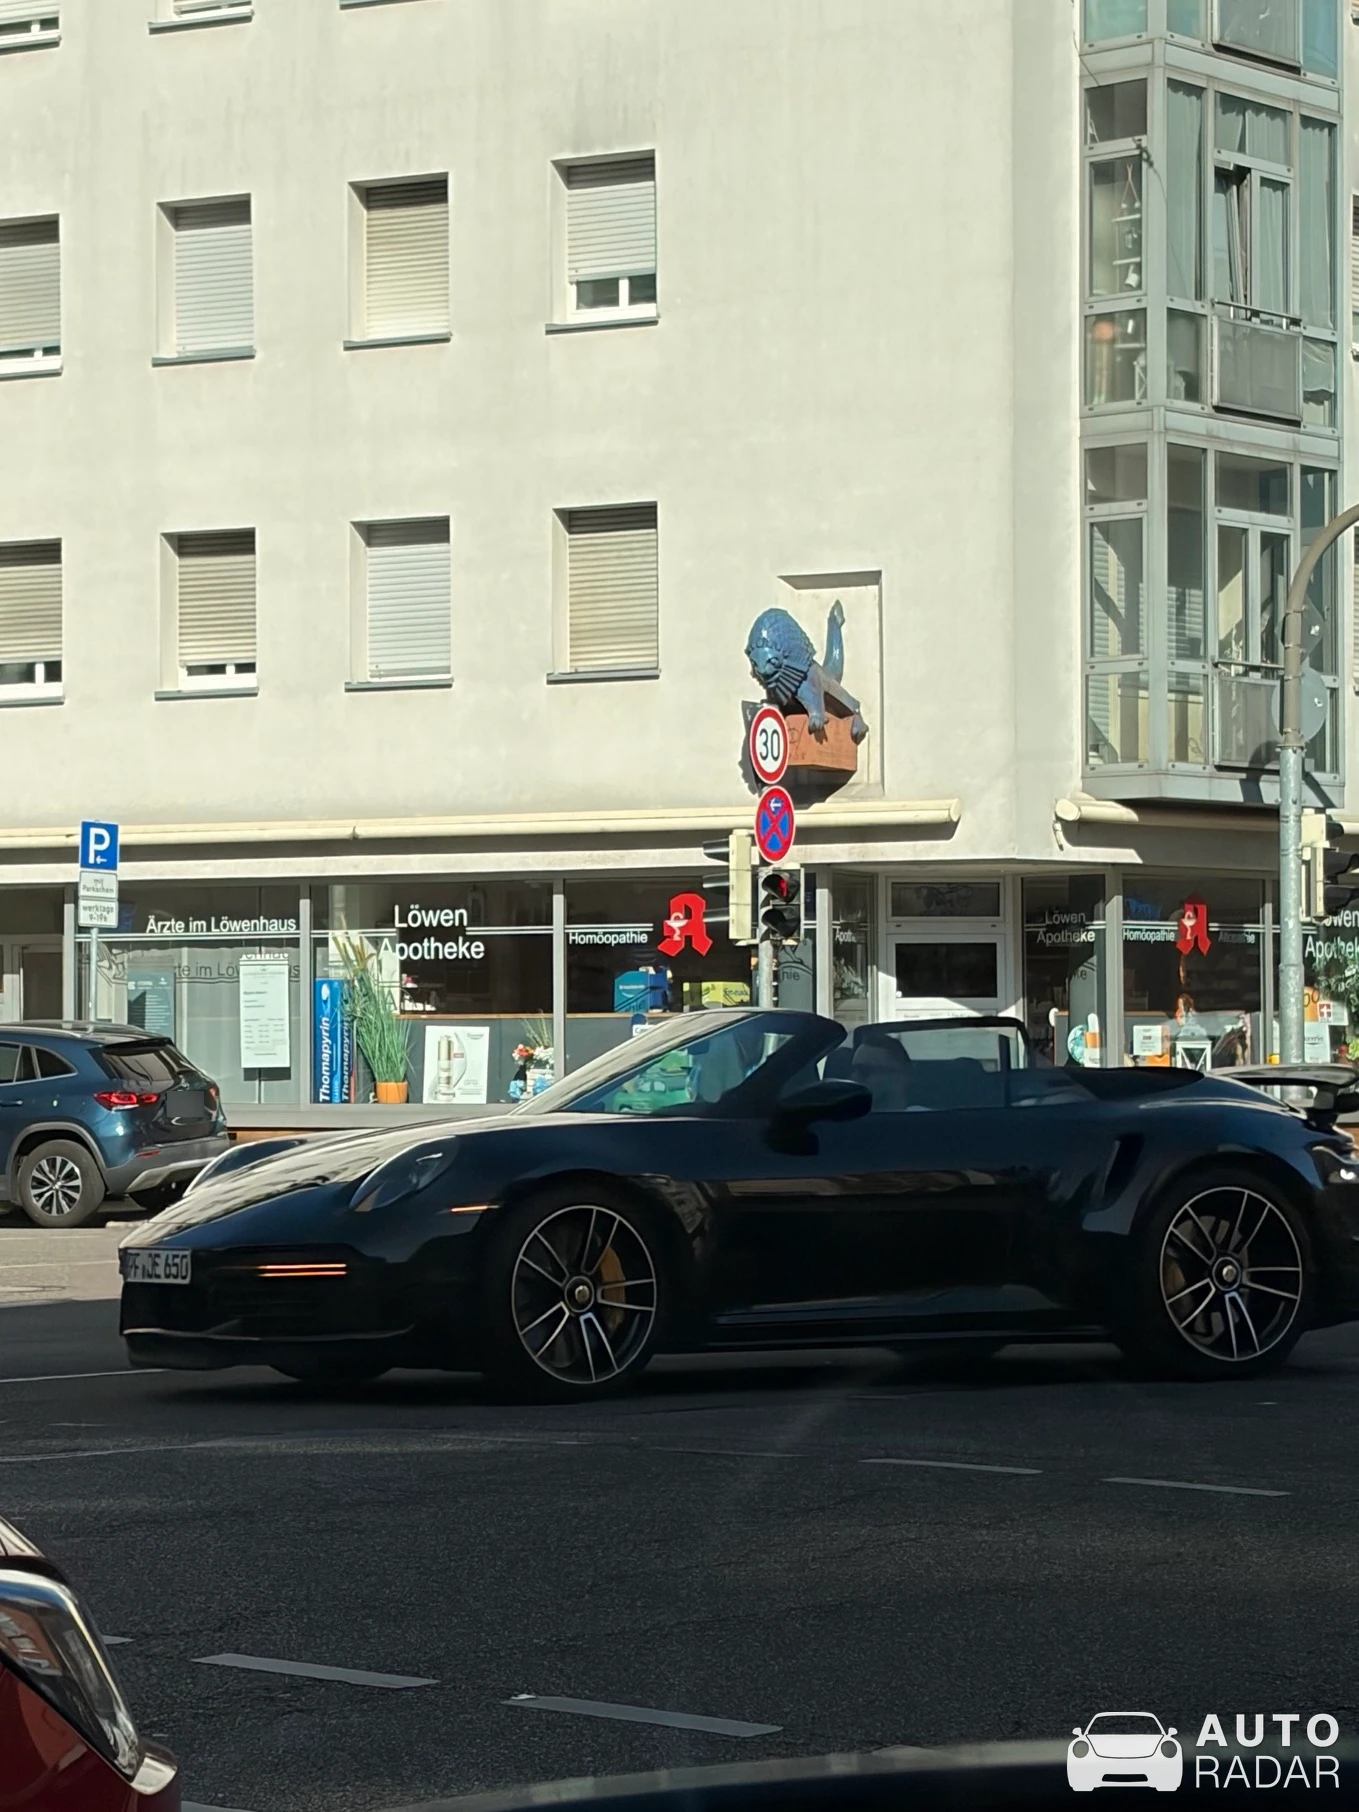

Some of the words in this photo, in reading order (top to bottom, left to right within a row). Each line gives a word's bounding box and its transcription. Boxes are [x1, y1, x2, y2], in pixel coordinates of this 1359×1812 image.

[759, 728, 781, 761] 30
[88, 827, 110, 864] P
[146, 915, 185, 933] Ärzte
[189, 917, 207, 932] im
[211, 916, 297, 932] Löwenhaus
[394, 904, 468, 928] Löwen
[1045, 910, 1086, 924] Löwen
[568, 931, 648, 946] Homöopathie
[1037, 928, 1095, 947] Apotheke
[1122, 928, 1175, 944] Homöopathie
[378, 936, 485, 961] Apotheke
[319, 1016, 331, 1102] Thomapyrin
[164, 1253, 189, 1280] 650
